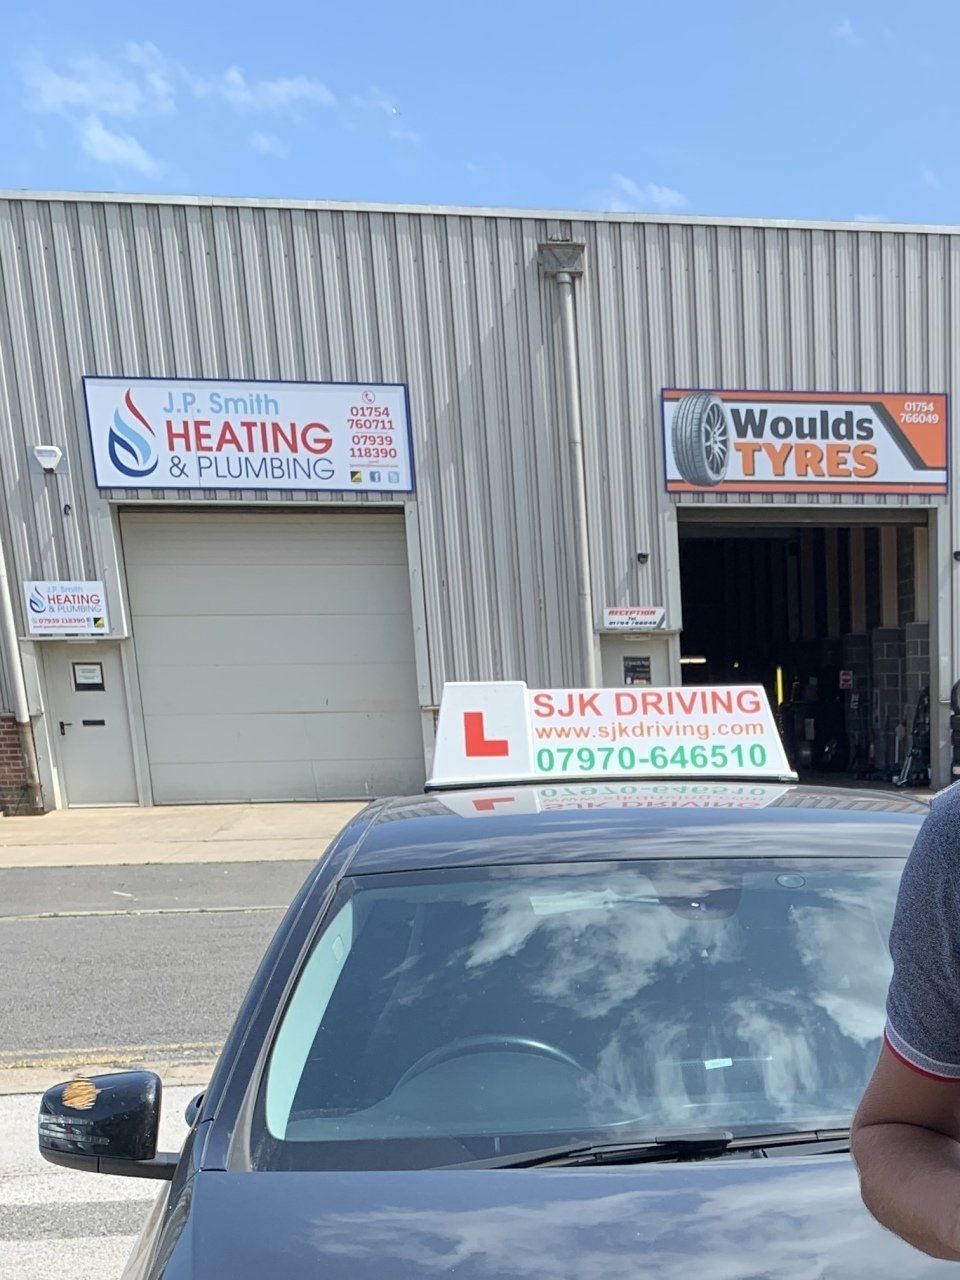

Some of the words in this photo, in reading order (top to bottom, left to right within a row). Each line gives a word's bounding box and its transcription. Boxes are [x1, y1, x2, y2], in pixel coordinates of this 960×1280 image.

[163, 392, 201, 415] J.P.
[210, 392, 280, 416] Smith
[350, 406, 390, 417] 01754
[904, 401, 934, 412] 01754
[347, 419, 395, 430] 760711
[730, 408, 874, 441] Woulds
[900, 413, 939, 424] 766049
[166, 420, 333, 455] HEATING
[352, 434, 393, 446] 07939
[349, 448, 397, 458] 118390
[733, 442, 878, 478] TYRES
[170, 455, 189, 478] &
[199, 457, 335, 480] PLUMBING
[48, 594, 101, 605] HEATING
[58, 605, 102, 613] PLUMBING
[533, 692, 604, 718] SJK
[615, 690, 761, 716] DRIVING
[463, 711, 509, 758] L
[536, 720, 765, 743] www.sjkdriving.com
[536, 744, 767, 773] 07970-646510
